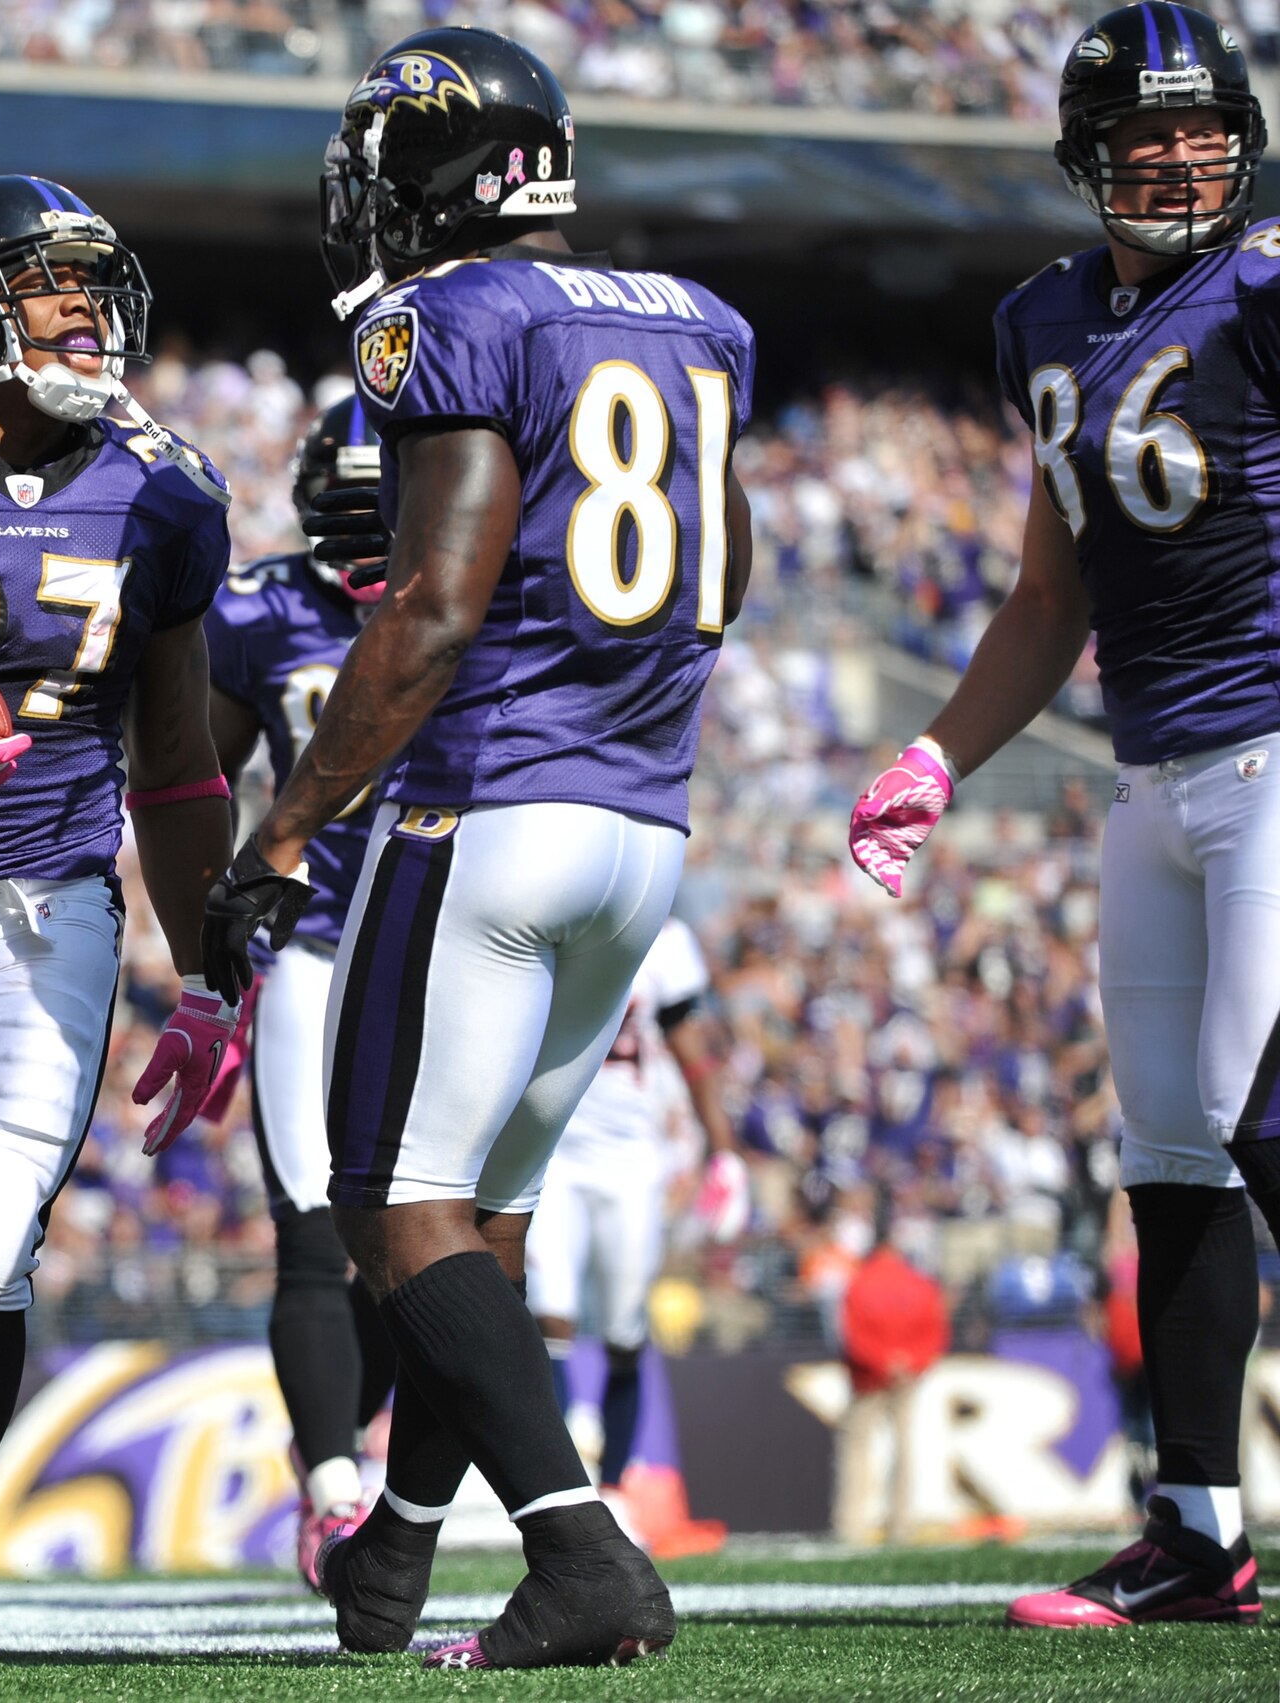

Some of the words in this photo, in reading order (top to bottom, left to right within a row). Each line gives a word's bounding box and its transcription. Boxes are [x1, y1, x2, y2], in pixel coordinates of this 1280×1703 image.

[1157, 74, 1195, 85] Riddell
[480, 184, 497, 198] NFL
[532, 261, 705, 321] BOLDIN
[361, 315, 407, 341] RAVENS
[1028, 345, 1208, 543] 86
[566, 359, 731, 634] 81
